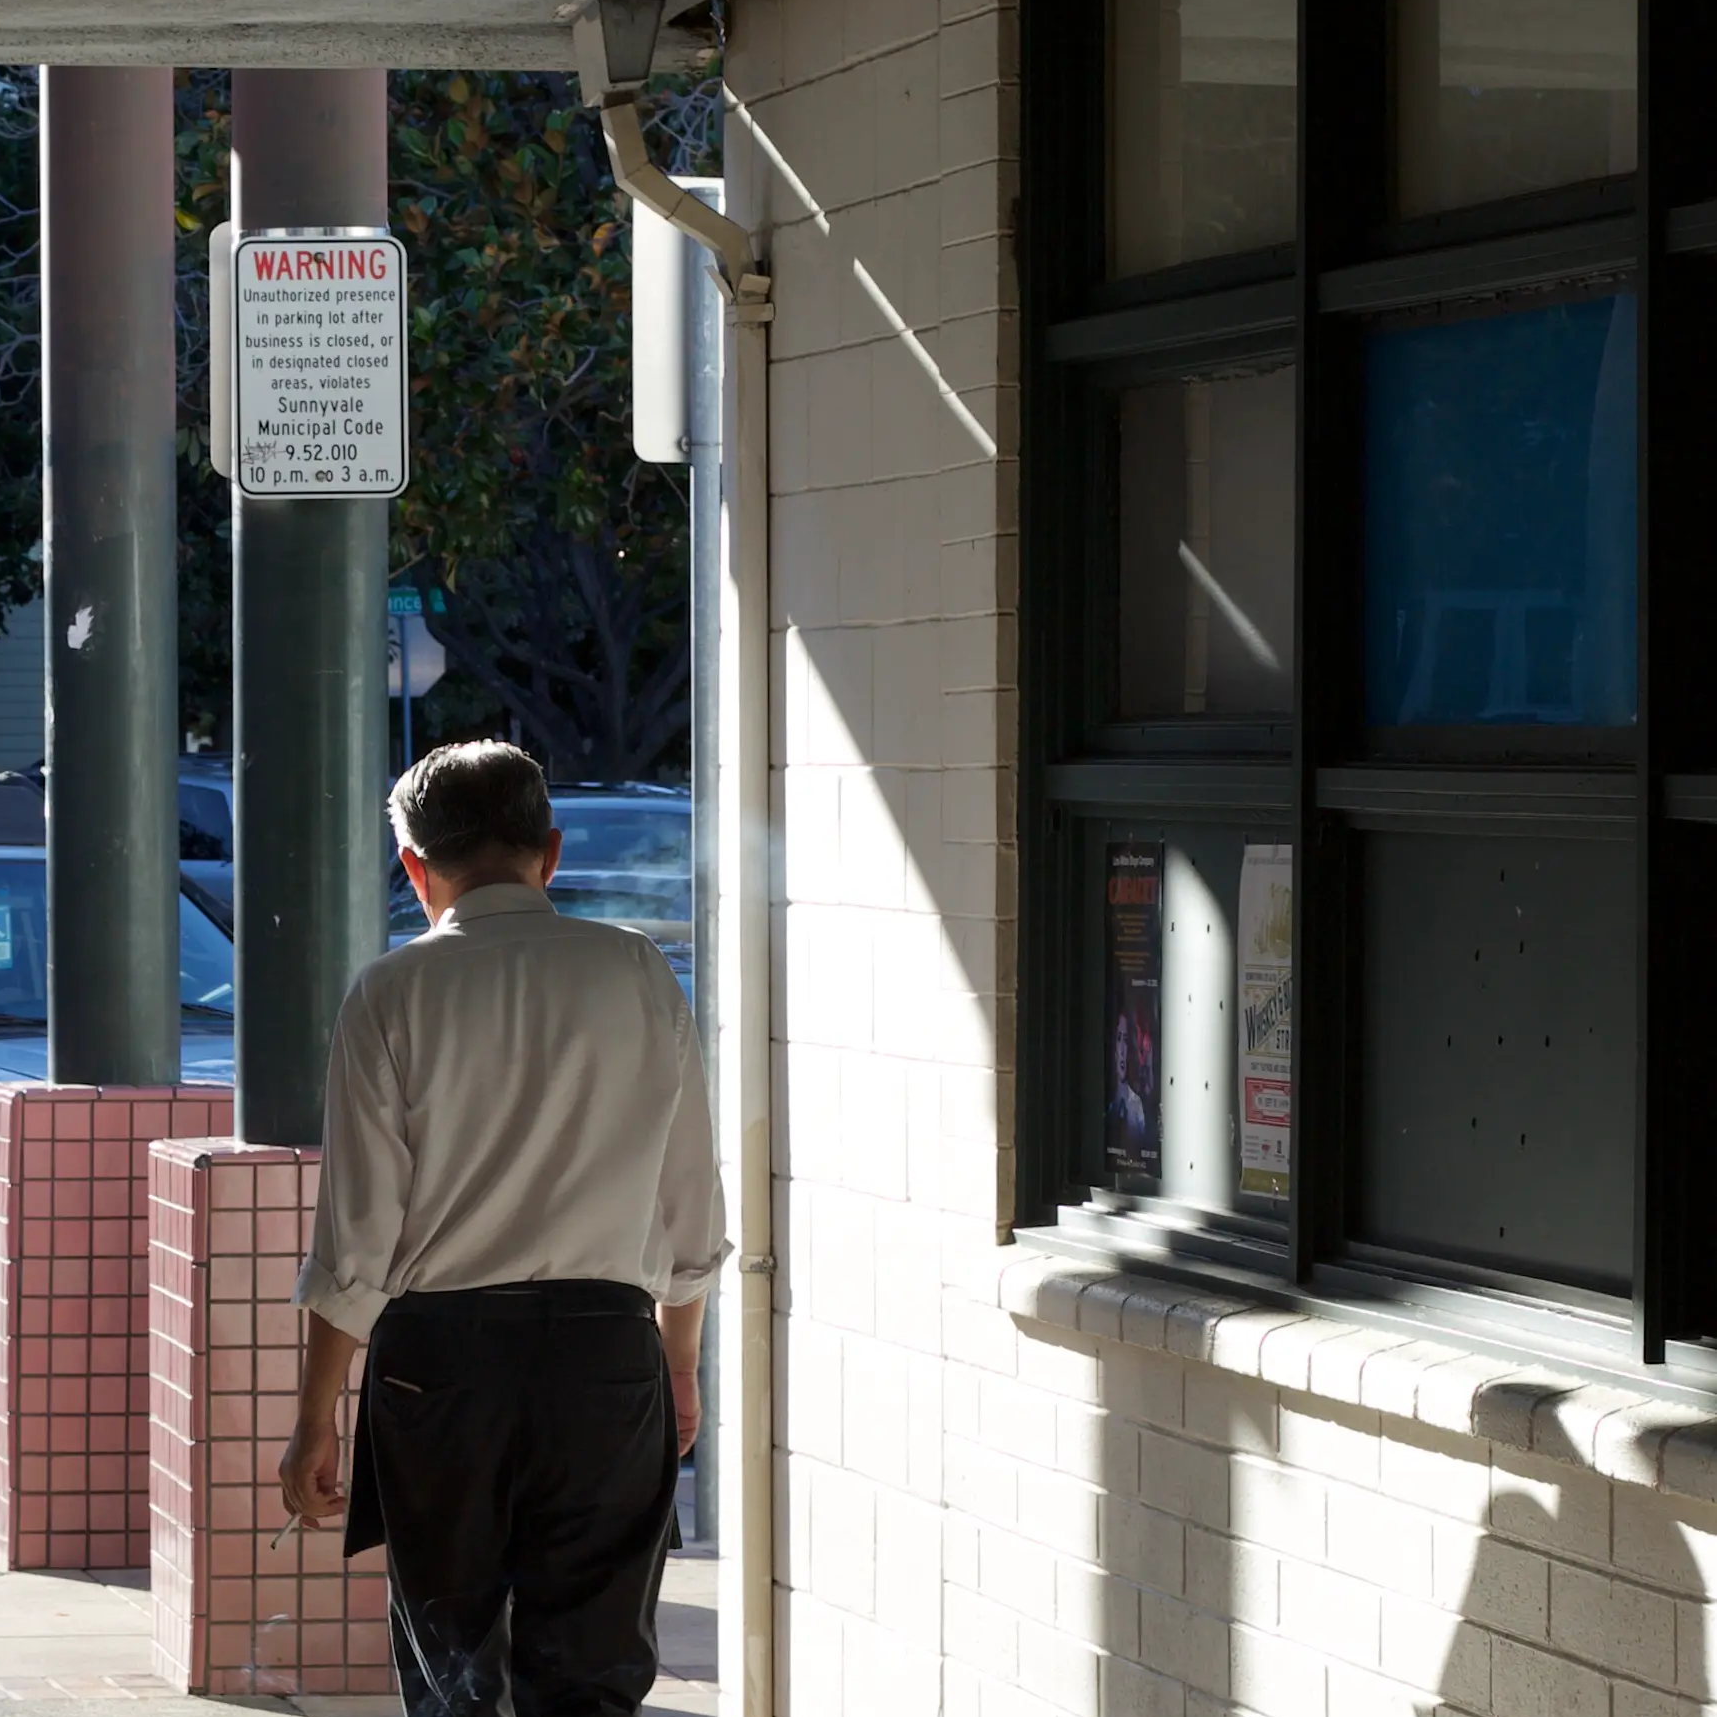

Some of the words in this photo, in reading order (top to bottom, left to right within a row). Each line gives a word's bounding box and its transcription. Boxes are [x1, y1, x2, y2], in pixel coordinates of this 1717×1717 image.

[254, 249, 385, 280] WARNING
[244, 289, 329, 302] Unauthorized
[336, 291, 395, 304] presence
[257, 314, 268, 325] in
[276, 312, 322, 328] parking
[329, 311, 344, 324] lot
[352, 311, 383, 323] after
[246, 336, 302, 347] business
[309, 334, 320, 347] is
[327, 334, 374, 348] closed,
[381, 336, 393, 346] or
[252, 355, 263, 368] in
[270, 356, 340, 372] designated
[347, 355, 388, 368] closed
[272, 379, 313, 390] areas,
[320, 377, 370, 389] violates
[279, 397, 363, 416] Sunnyvale
[259, 420, 335, 439] Municipal
[344, 419, 383, 435] Code
[286, 444, 357, 461] 9.52.010
[250, 467, 265, 483] 10
[274, 470, 308, 486] p.m.
[315, 468, 333, 482] o
[342, 466, 350, 482] 3
[359, 469, 394, 482] a.m.
